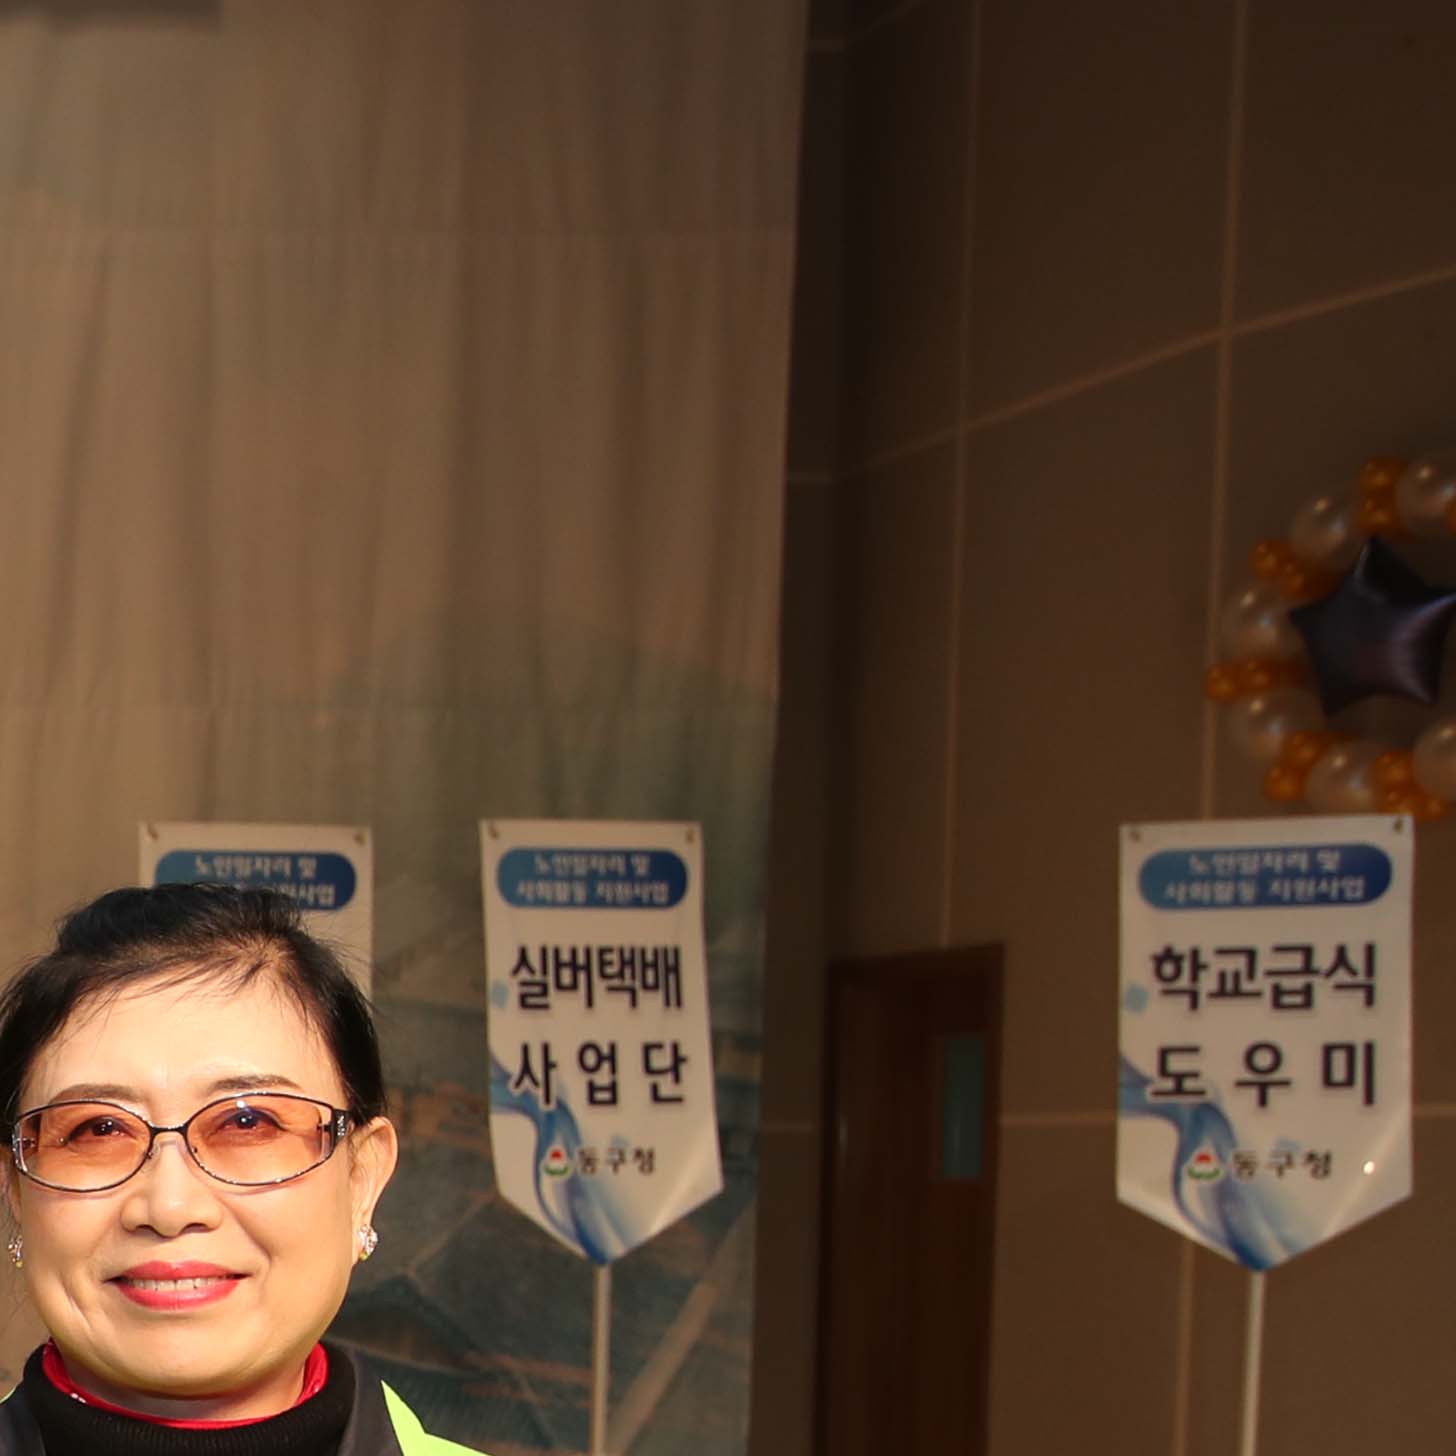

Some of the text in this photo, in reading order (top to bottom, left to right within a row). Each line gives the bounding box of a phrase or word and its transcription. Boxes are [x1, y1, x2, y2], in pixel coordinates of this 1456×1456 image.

[510, 944, 684, 1011] 실버택배
[1151, 941, 1378, 1012] 학교급식
[576, 1146, 657, 1176] 동구청
[1233, 1149, 1333, 1181] 동구청
